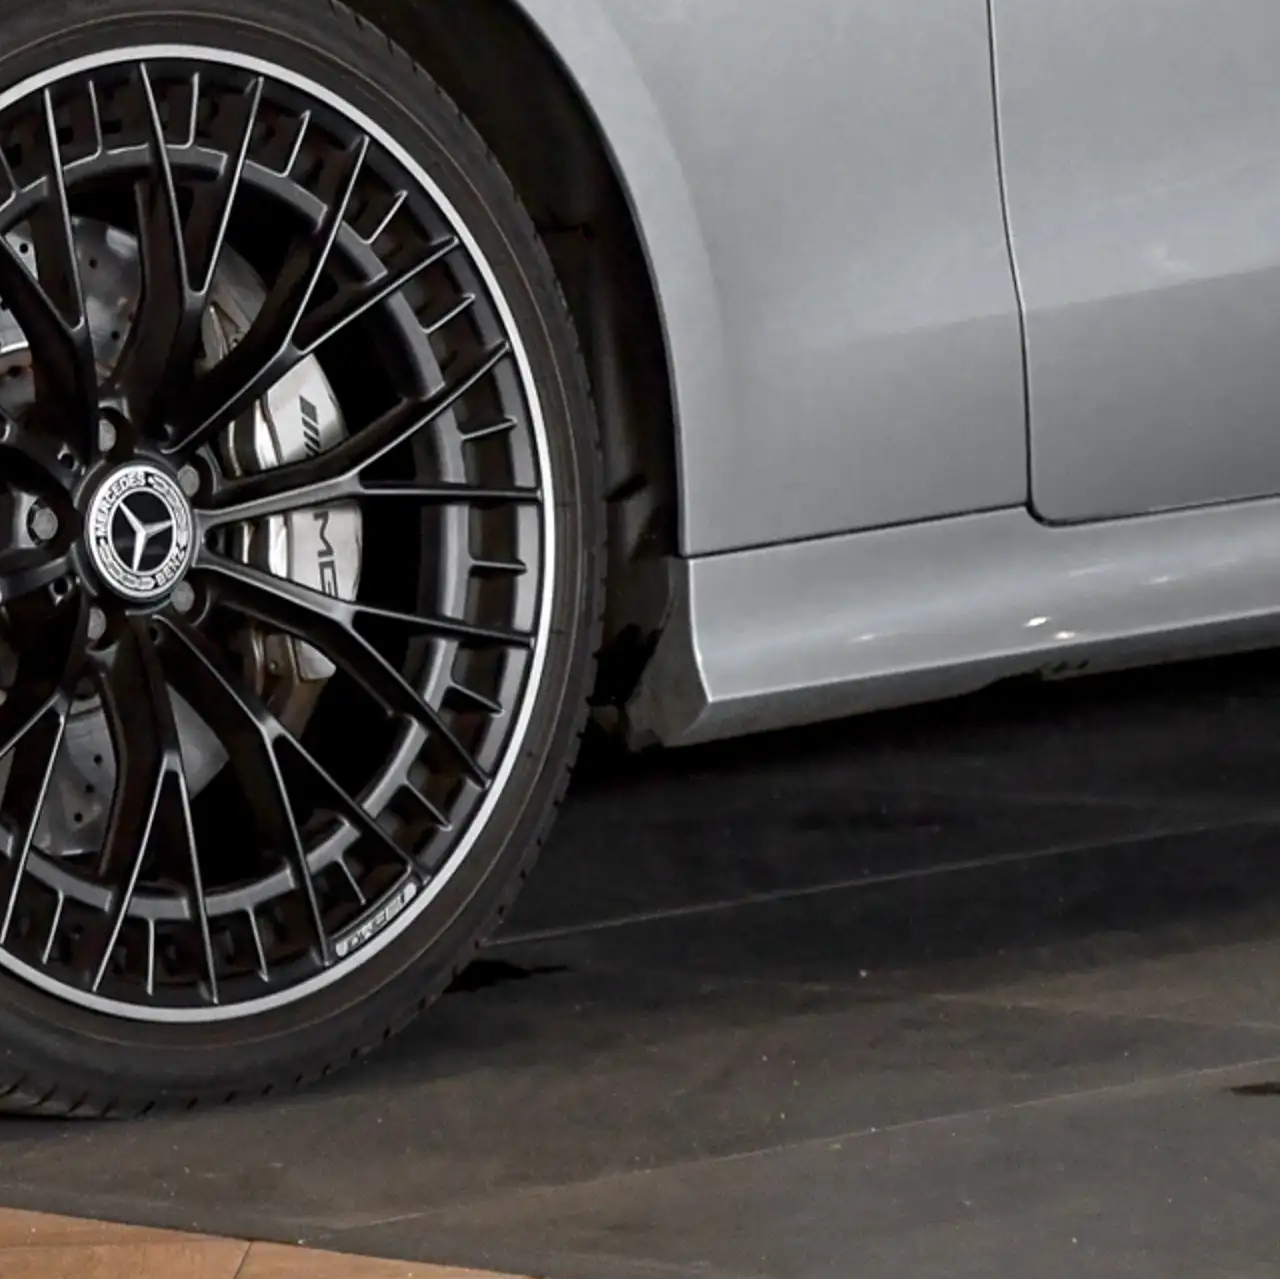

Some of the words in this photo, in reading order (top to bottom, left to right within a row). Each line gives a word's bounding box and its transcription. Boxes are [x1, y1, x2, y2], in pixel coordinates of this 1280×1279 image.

[95, 471, 146, 537] MERCEDES
[154, 546, 186, 587] BENZ
[312, 511, 339, 599] MG
